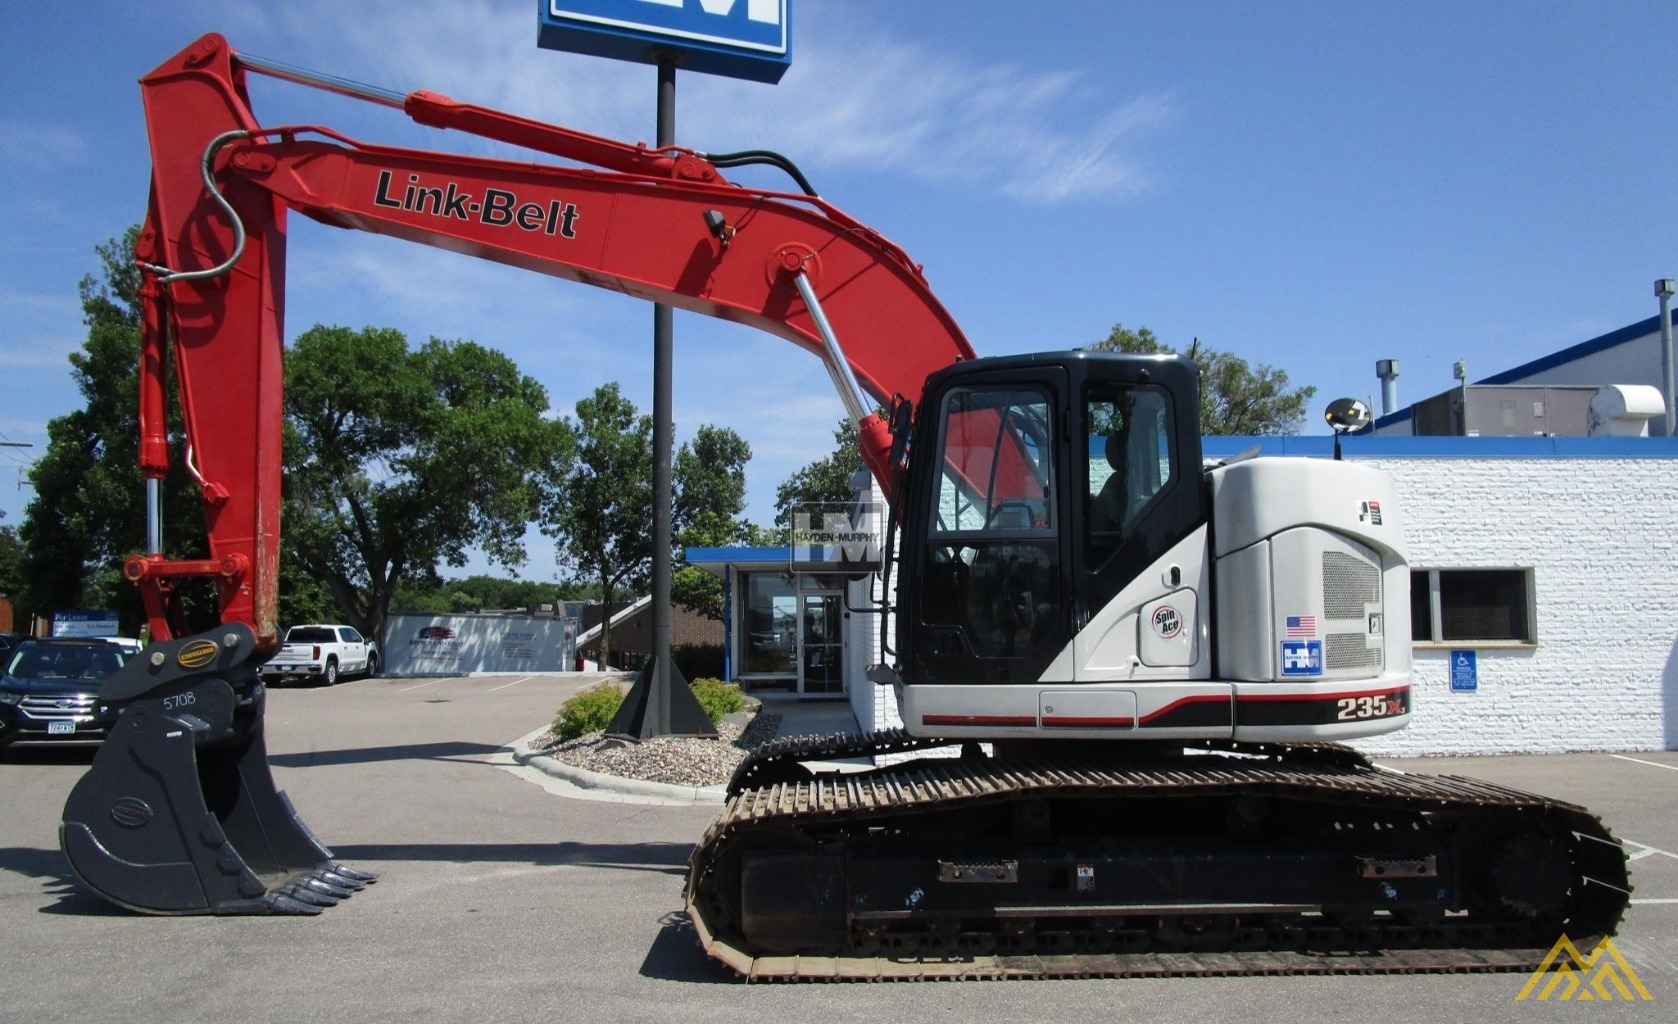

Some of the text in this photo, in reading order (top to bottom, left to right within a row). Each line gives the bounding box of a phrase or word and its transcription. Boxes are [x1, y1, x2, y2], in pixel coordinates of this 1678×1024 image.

[374, 169, 580, 239] Link-Belt
[1155, 610, 1175, 624] Spin
[1162, 620, 1179, 634] Ace
[163, 691, 196, 710] 5708
